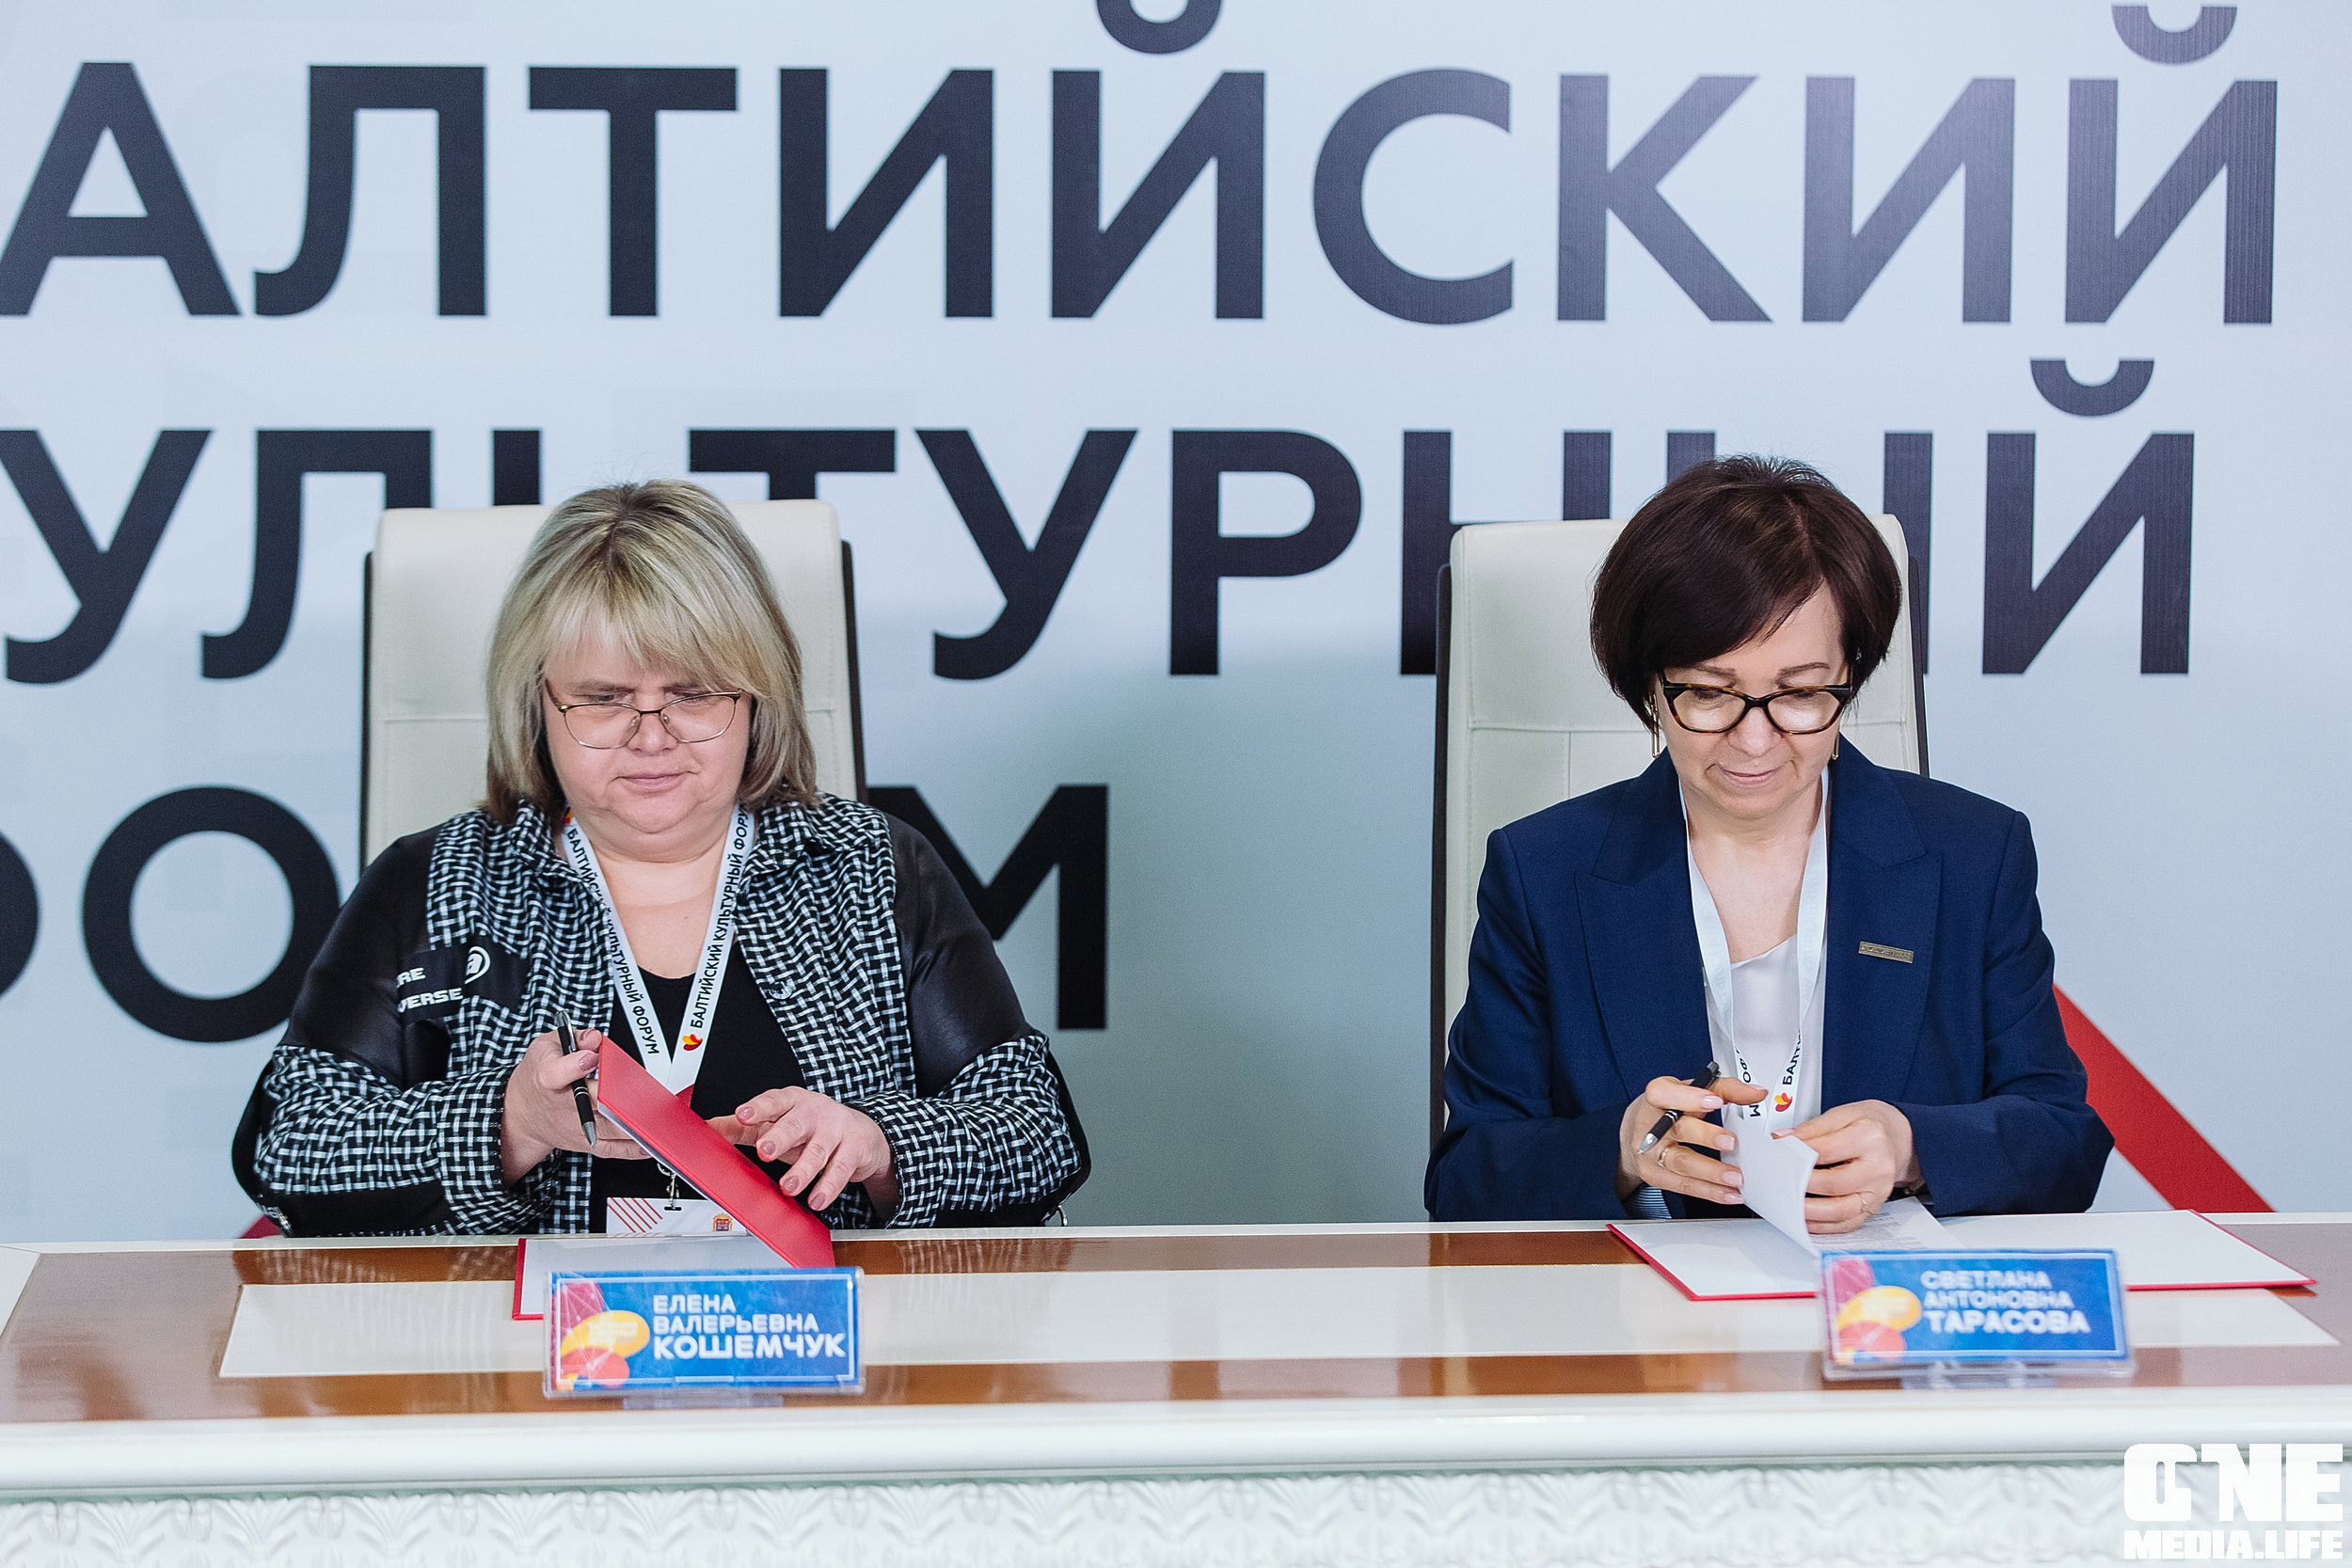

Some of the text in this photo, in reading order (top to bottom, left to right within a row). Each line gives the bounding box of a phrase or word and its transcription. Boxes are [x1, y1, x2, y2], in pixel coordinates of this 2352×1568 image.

[690, 804, 749, 1029] БАЛТИЙСКИЙ КУЛЬТУРНЫЙ ФОРУ
[632, 1005, 660, 1055] ФОРУМ
[1920, 1270, 2053, 1290] СВЕТЛАНА
[652, 1293, 737, 1315] ЕЛЕНА
[1923, 1290, 2074, 1310] АНТОНОВНА
[652, 1313, 820, 1335] ВАЛЕРЬЕВНА
[1928, 1309, 2091, 1335] ТАРАСОВА
[653, 1332, 847, 1360] КОШЕМЧУК
